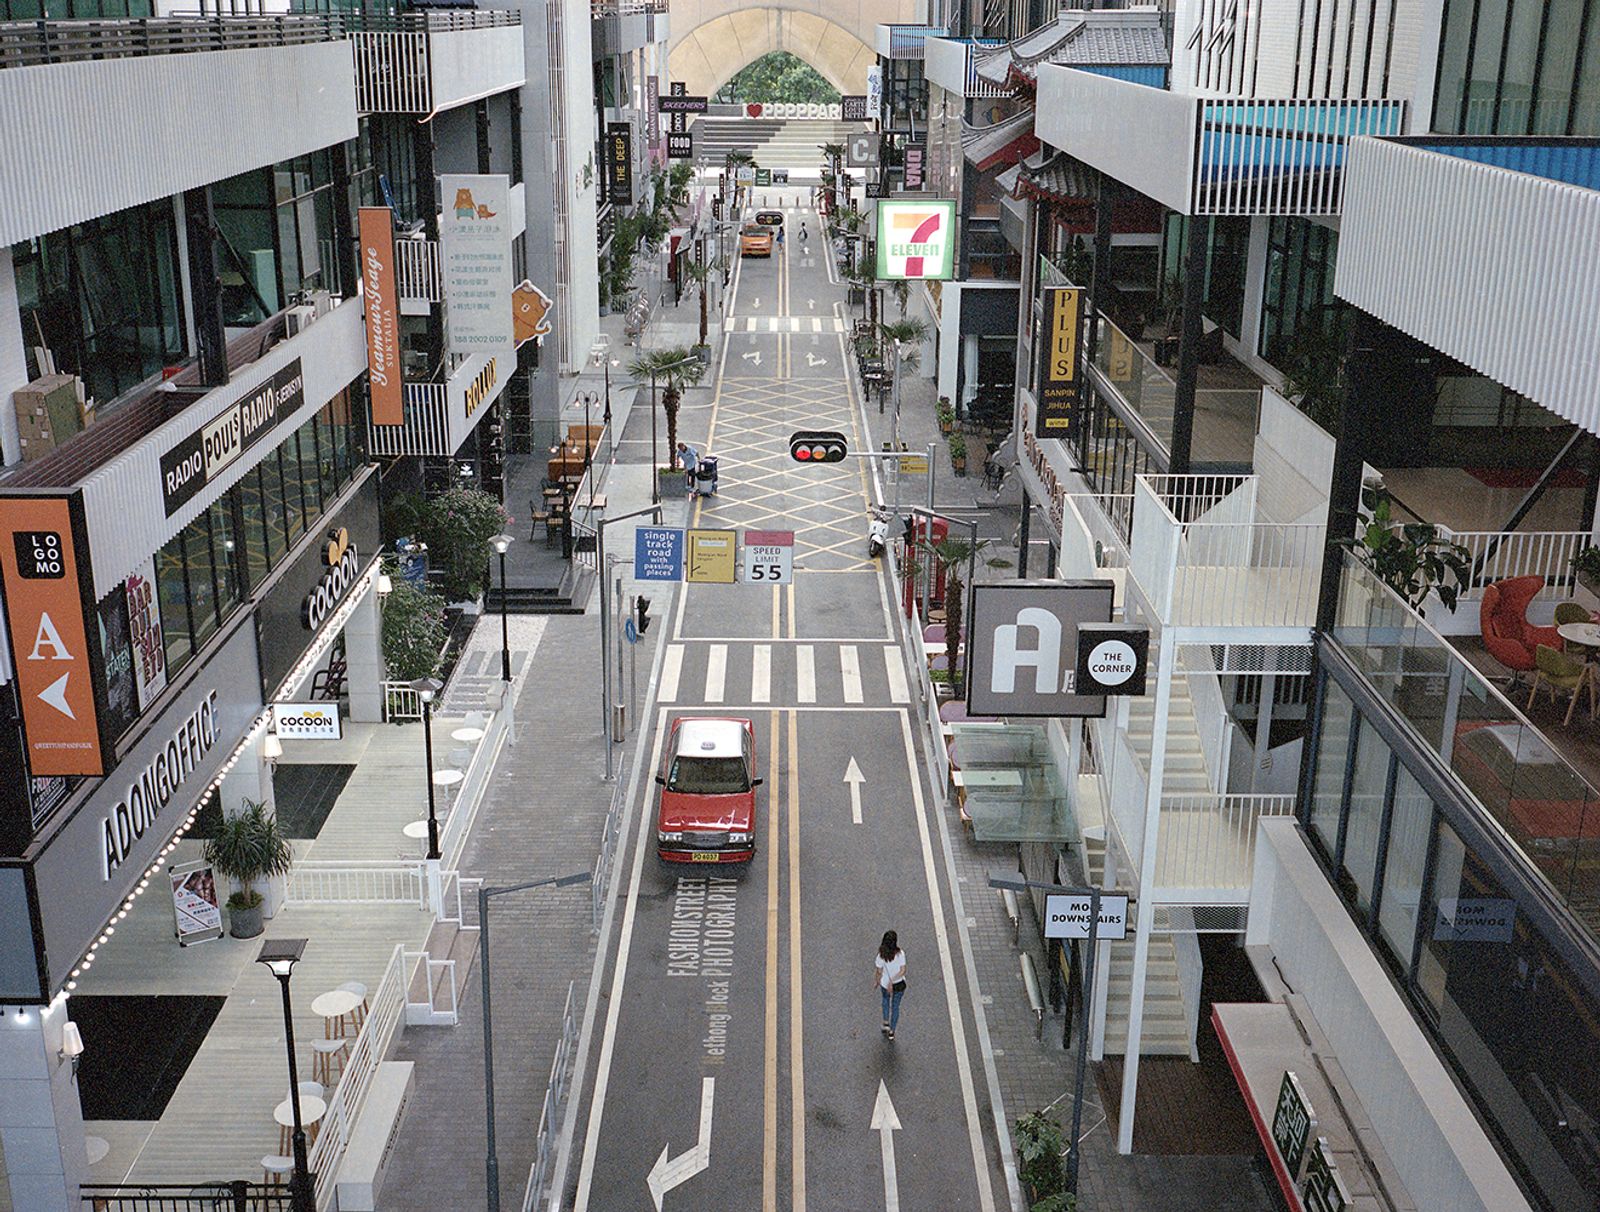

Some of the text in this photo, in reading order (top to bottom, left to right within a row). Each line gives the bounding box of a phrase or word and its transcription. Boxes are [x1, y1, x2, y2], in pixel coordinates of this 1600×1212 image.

[662, 101, 705, 109] SKECHERS
[670, 137, 690, 148] FOOD
[615, 138, 626, 161] DEEP
[616, 165, 626, 182] THE
[906, 150, 922, 187] DNA
[1056, 291, 1073, 376] PLUS
[1046, 402, 1071, 410] JIHUA
[166, 450, 203, 496] RADIO
[242, 387, 275, 437] RADIO
[644, 531, 676, 541] single
[646, 540, 674, 548] track
[647, 549, 672, 557] road
[753, 546, 781, 555] SPEED
[650, 556, 668, 564] with
[755, 555, 779, 563] LIMIT
[643, 563, 674, 571] passing
[646, 569, 672, 577] places
[751, 564, 782, 581] 55
[307, 542, 359, 631] COCOON
[27, 612, 75, 660] A
[1103, 652, 1122, 661] THE
[1092, 664, 1132, 673] CORNER
[280, 717, 333, 727] COCOON
[1070, 903, 1104, 912] MOE
[1052, 914, 1122, 924] DOWNSAIRS
[701, 877, 738, 977] PHOTOGRAPHY
